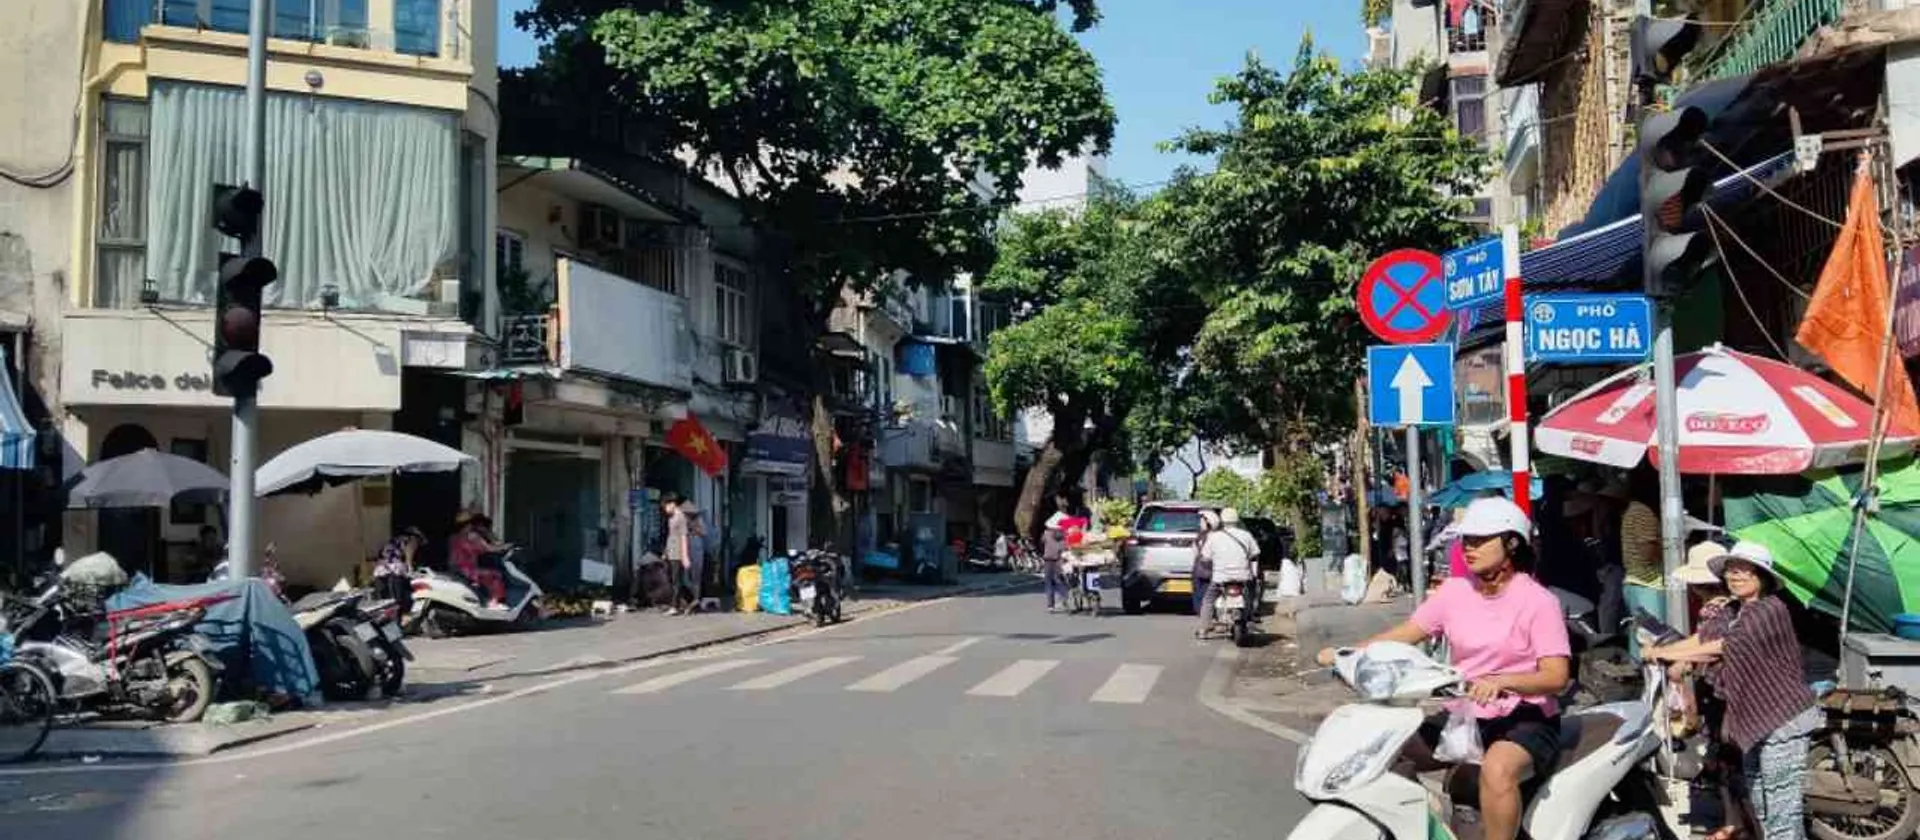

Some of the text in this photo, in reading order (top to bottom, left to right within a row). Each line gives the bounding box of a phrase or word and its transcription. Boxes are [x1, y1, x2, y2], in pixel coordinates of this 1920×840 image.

[1477, 265, 1500, 294] TÂY
[1576, 300, 1616, 318] PHỐ
[1539, 321, 1642, 355] NGỌC HÀ
[91, 369, 166, 390] Felice
